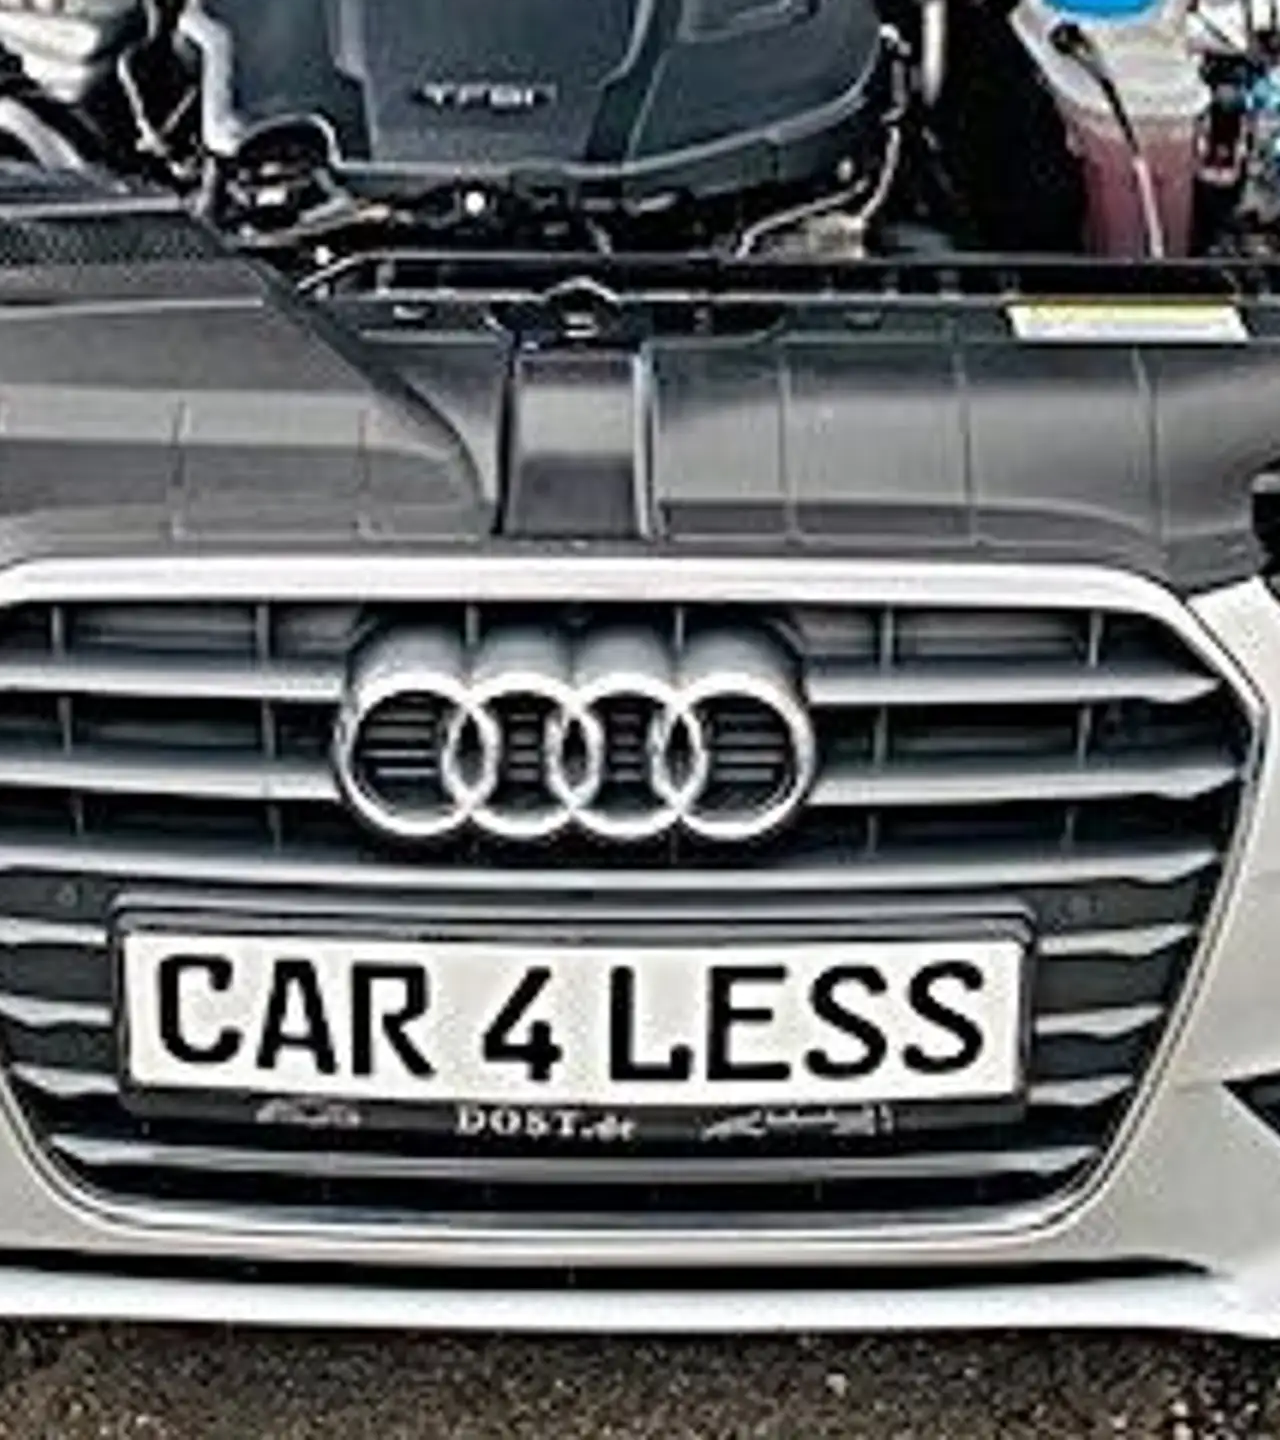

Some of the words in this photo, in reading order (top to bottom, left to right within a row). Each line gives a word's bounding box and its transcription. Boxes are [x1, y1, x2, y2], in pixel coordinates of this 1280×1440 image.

[159, 954, 436, 1079] CAR
[483, 966, 563, 1082] 4
[609, 960, 984, 1081] LESS
